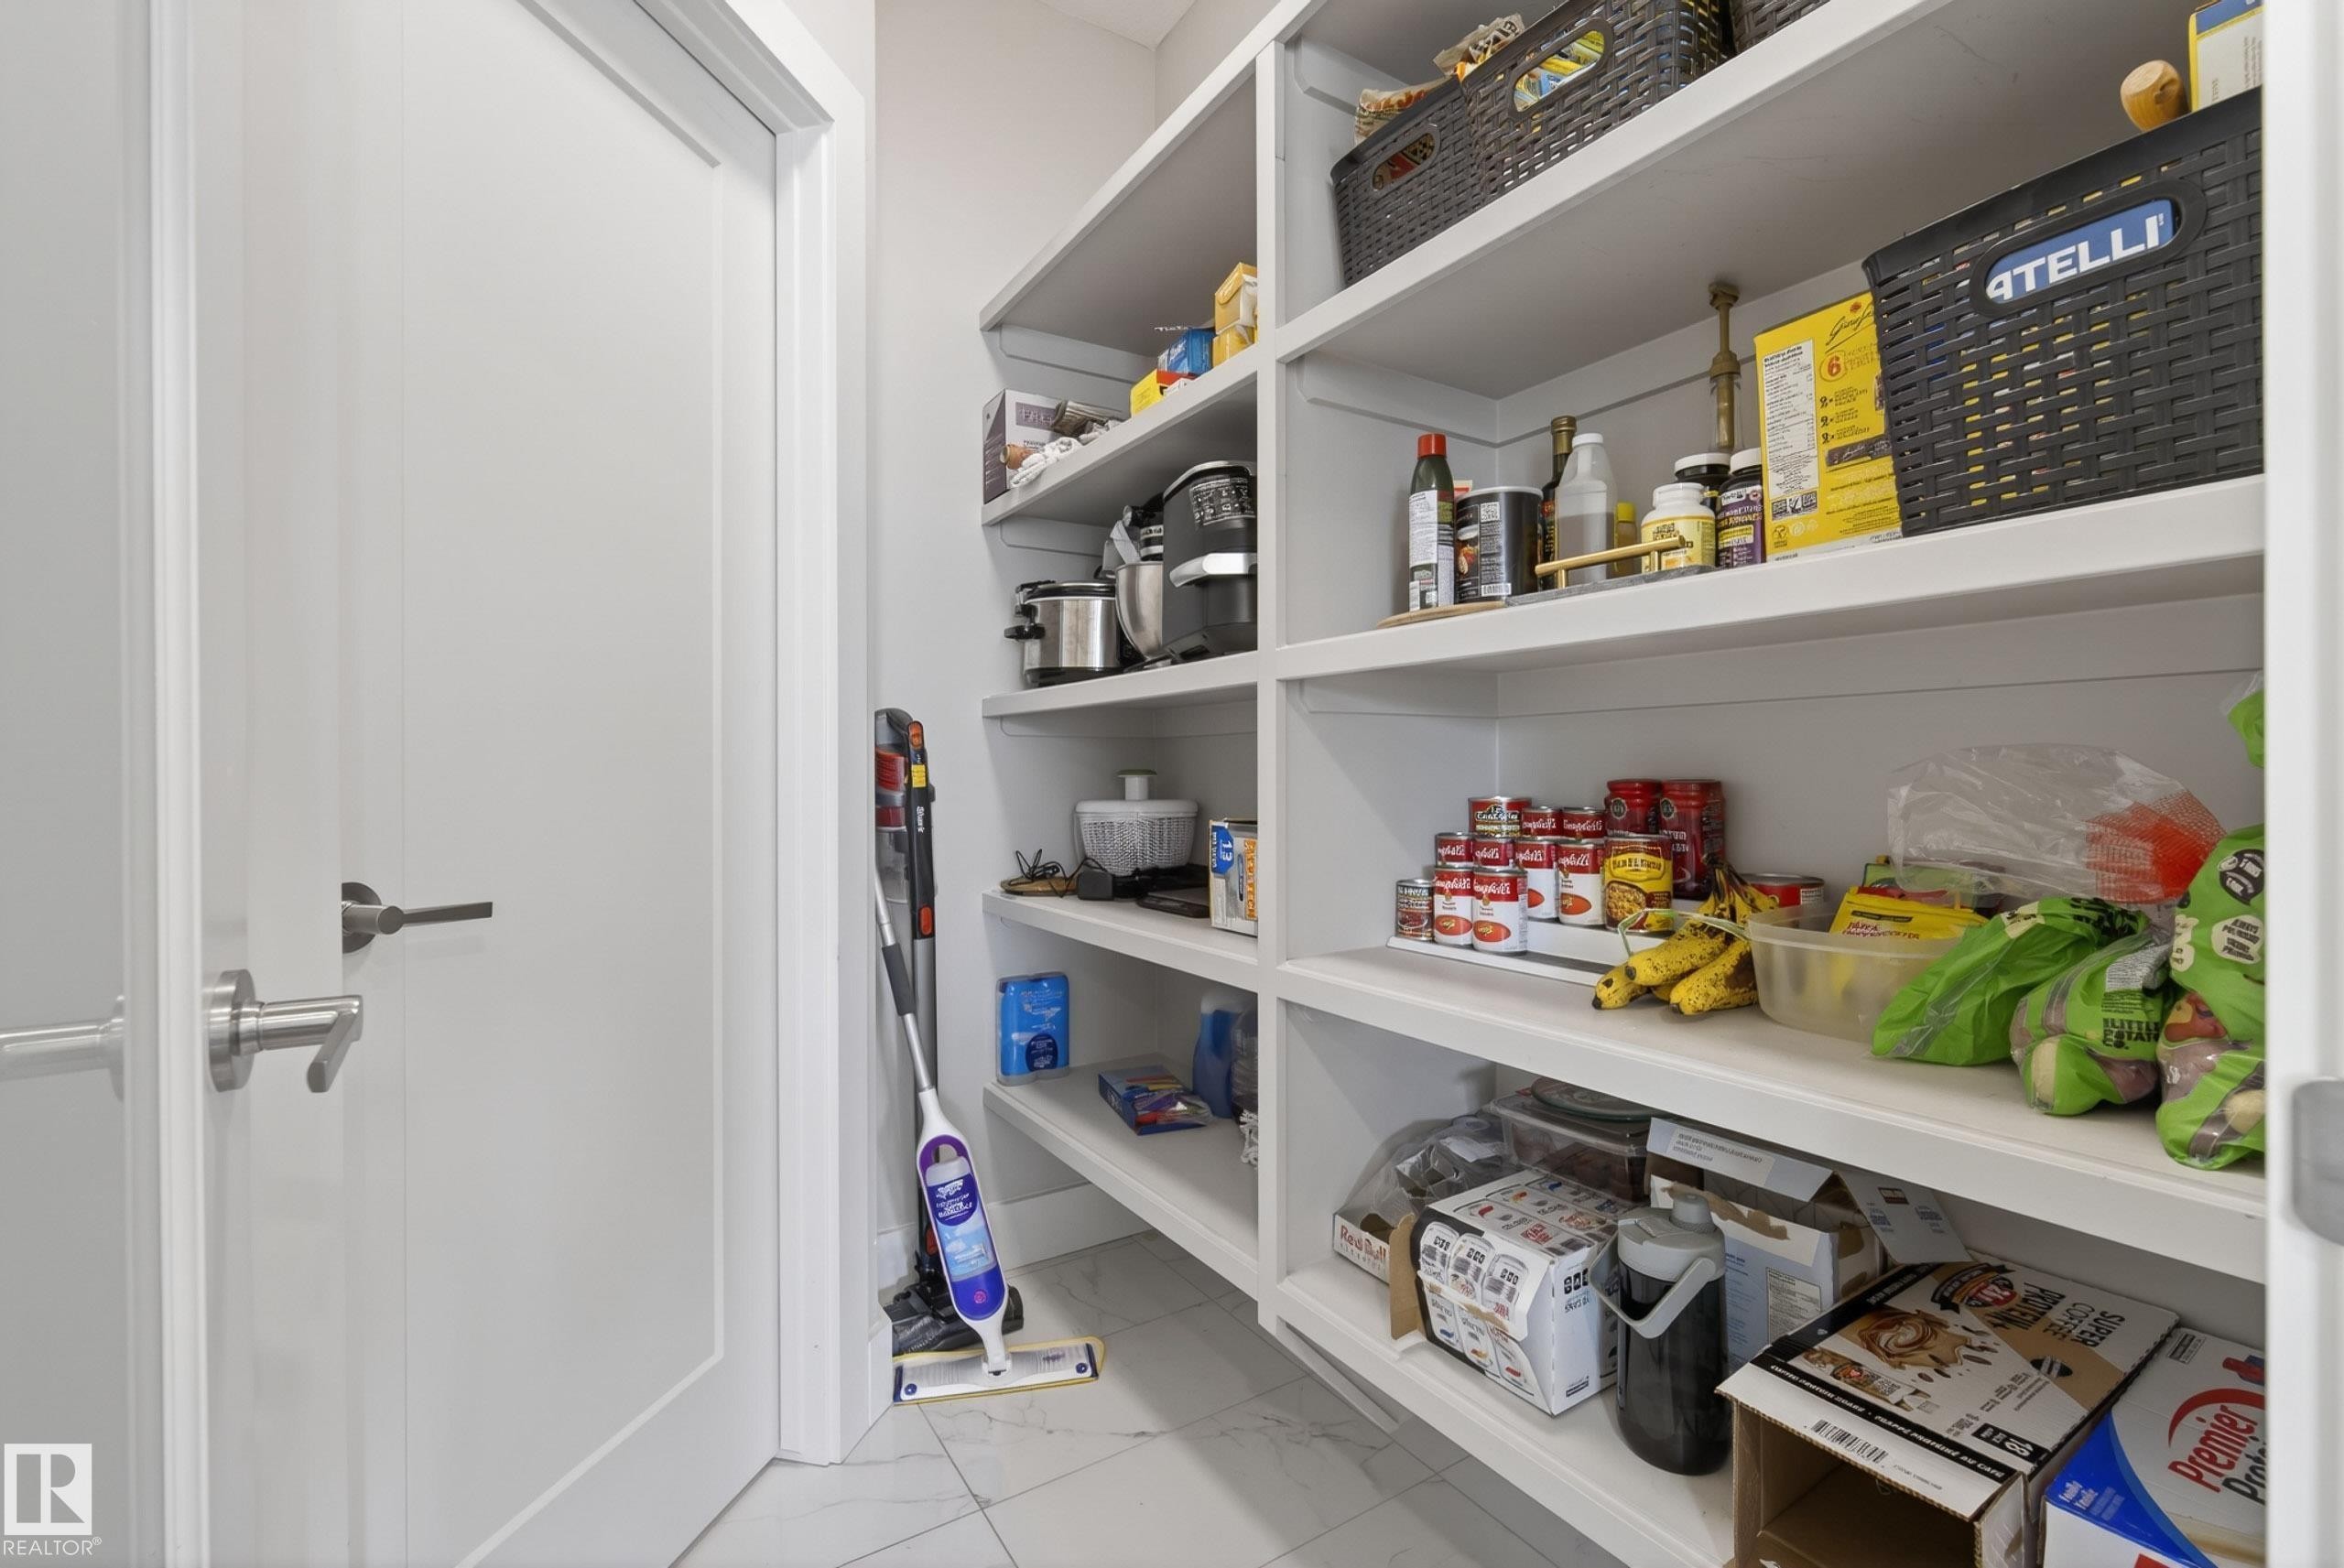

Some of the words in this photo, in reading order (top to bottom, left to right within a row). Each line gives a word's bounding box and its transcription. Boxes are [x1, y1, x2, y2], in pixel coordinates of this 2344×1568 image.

[1340, 1225, 1363, 1251] Red
[2070, 1311, 2125, 1348] SUPER
[2167, 1404, 2259, 1493] Premier
